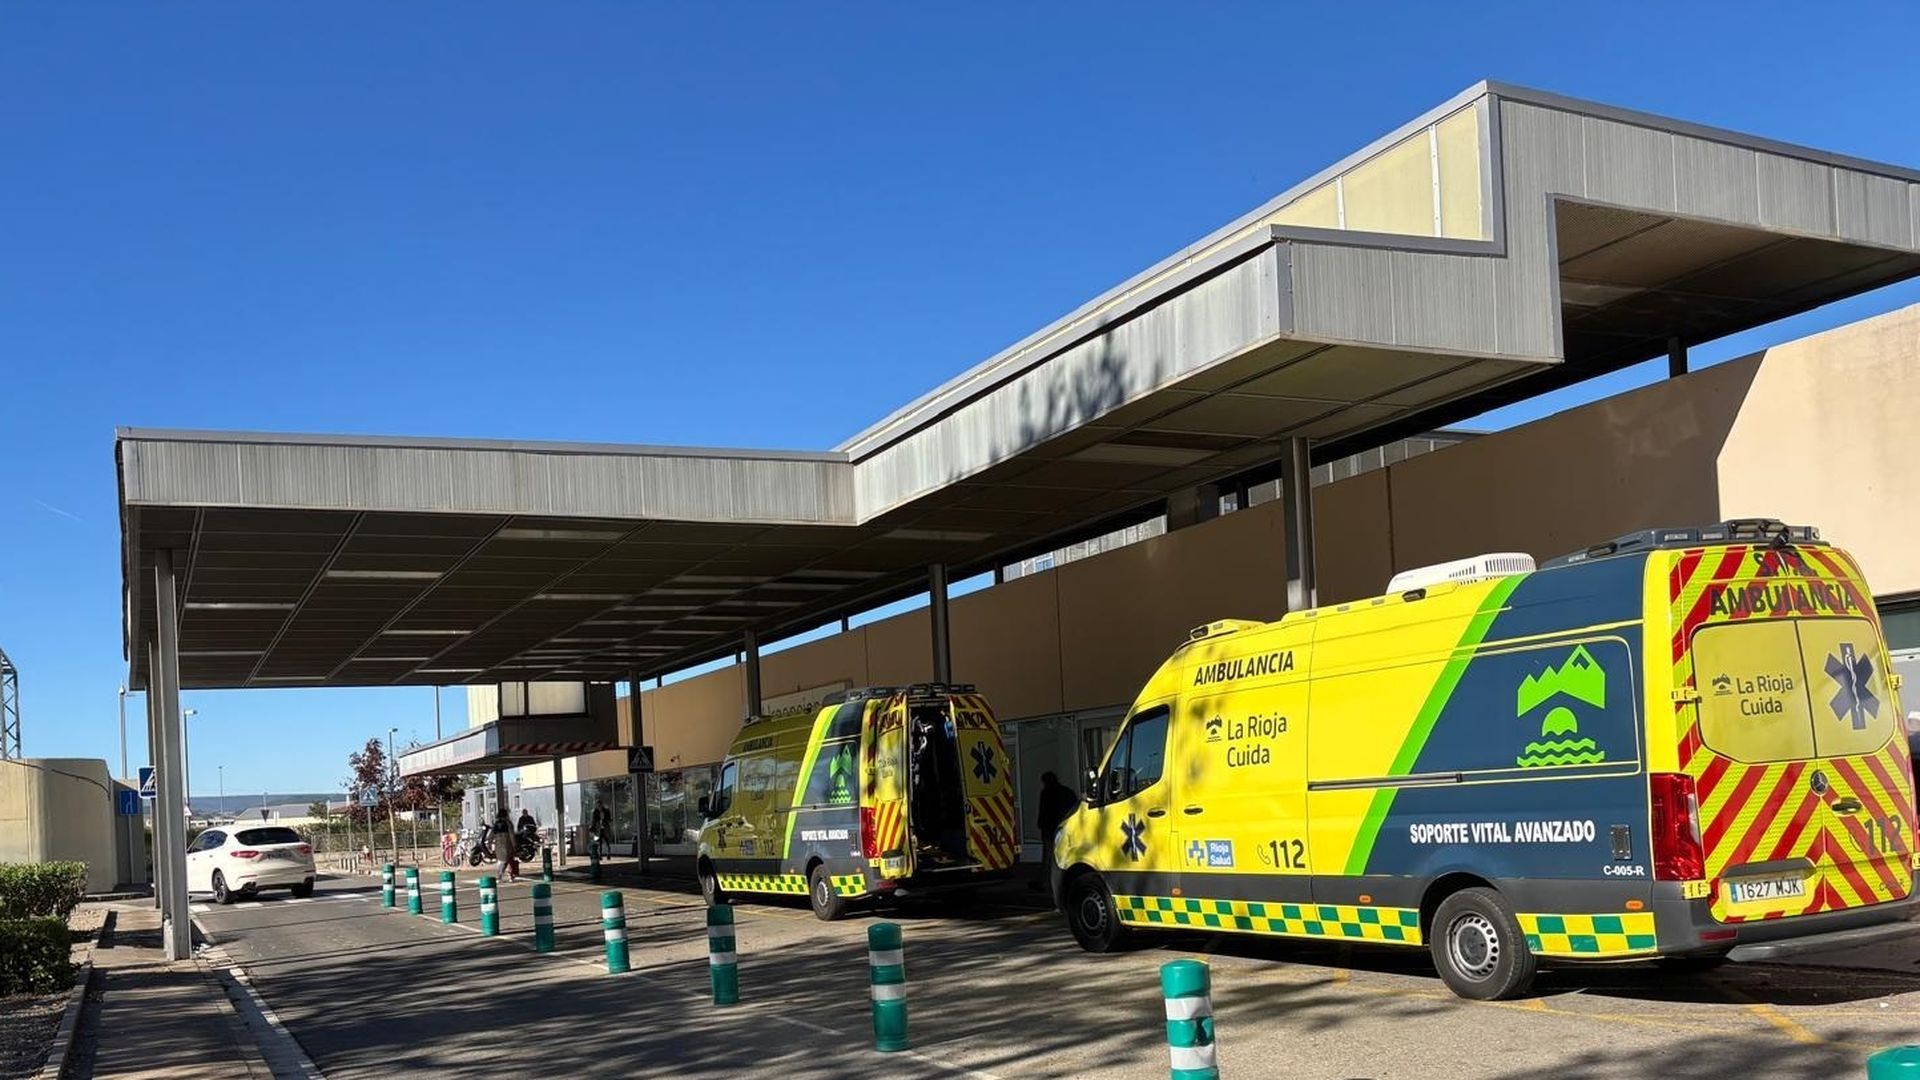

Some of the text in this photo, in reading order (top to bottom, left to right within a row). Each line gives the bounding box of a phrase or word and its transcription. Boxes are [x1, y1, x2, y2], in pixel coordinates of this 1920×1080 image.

[1193, 650, 1294, 687] AMBULANCIA
[1736, 673, 1794, 694] La Rioja
[1740, 697, 1783, 716] Cuida
[1227, 711, 1288, 740] La Rioja
[1227, 743, 1271, 768] Cuida
[1409, 819, 1596, 844] SOPORTE VITAL AVANZADO
[1864, 815, 1903, 853] 112
[1269, 838, 1306, 869] 112
[1603, 865, 1645, 876] C-005-R
[1739, 878, 1801, 899] 1627 MJK
